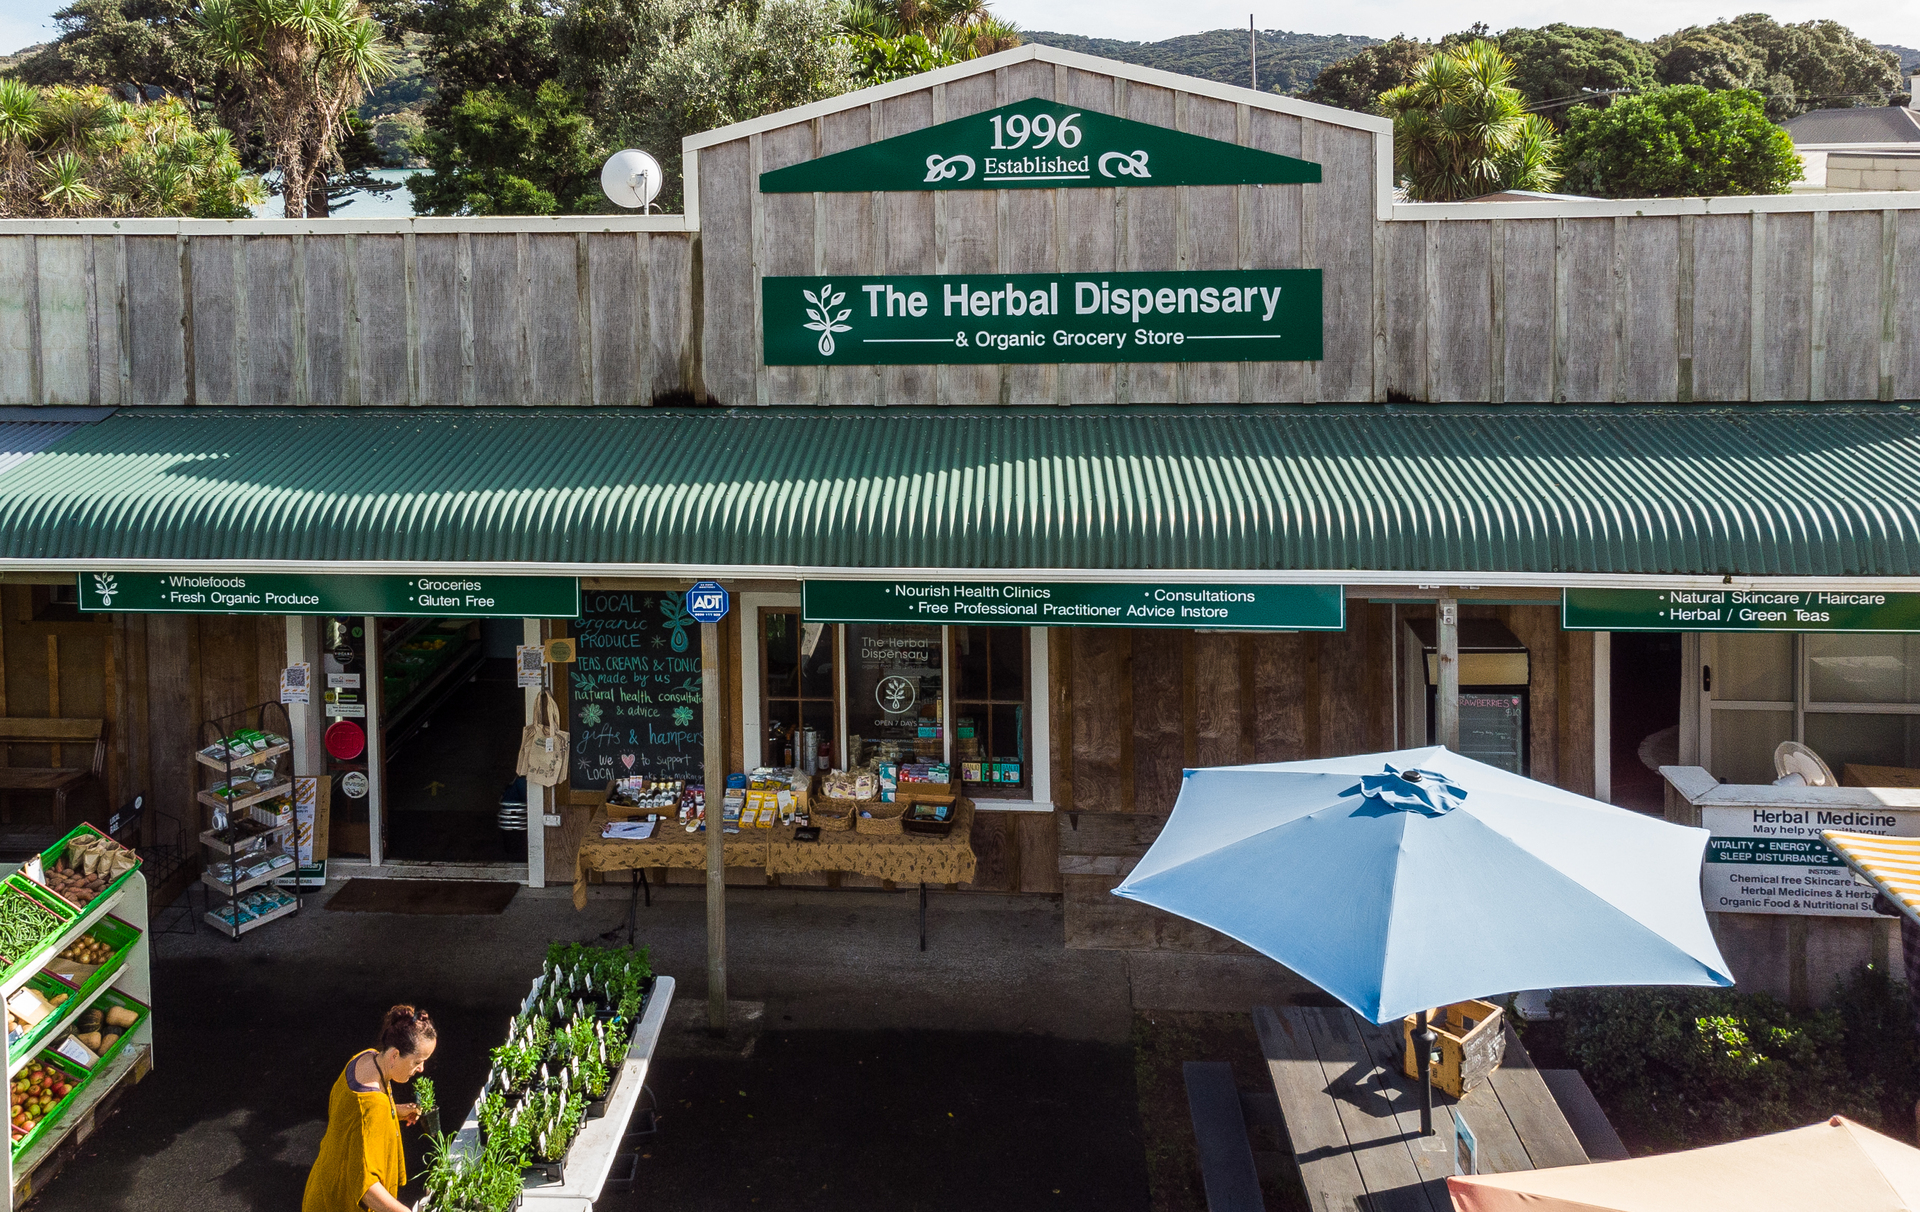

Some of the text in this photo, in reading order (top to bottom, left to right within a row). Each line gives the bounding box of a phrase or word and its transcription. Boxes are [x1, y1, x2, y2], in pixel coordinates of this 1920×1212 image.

[989, 113, 1083, 151] 1996
[984, 156, 1090, 175] Established
[862, 280, 1282, 323] The Herbal Dispensary
[955, 328, 1185, 351] & Organic Grocery Store
[169, 575, 246, 589] Wholefoods
[417, 578, 482, 592] Groceries
[170, 590, 319, 607] Fresh Organic Produce
[895, 584, 1051, 600] Nourish Health Clinics
[1154, 588, 1256, 603] Consultations
[1669, 591, 1886, 606] Natural Skincare / Haircare
[418, 594, 495, 608] Gluten Free
[585, 594, 641, 613] LOCAL
[694, 595, 722, 609] ADT
[918, 601, 1229, 619] Free Professional Practitioner Advice Instore
[1669, 608, 1830, 622] Herbal / Green Teas
[574, 617, 648, 636] organic
[580, 633, 641, 648] PRODUCE
[861, 637, 929, 648] The Herbal
[861, 648, 929, 662] Dispensary
[606, 656, 648, 671] CREAMS
[653, 659, 665, 671] &
[666, 657, 702, 672] TONIC
[597, 672, 671, 687] made by us
[574, 687, 615, 702] natural
[619, 685, 653, 704] health
[1459, 698, 1510, 708] RAWBERRIES
[616, 705, 660, 717] & advice
[576, 722, 621, 754] gifts
[628, 729, 639, 745] &
[598, 752, 692, 771] We to support
[1753, 809, 1897, 826] Herbal Medicine
[1753, 825, 1777, 834] May
[1779, 826, 1805, 836] help
[1807, 827, 1824, 836] yo
[1710, 840, 1811, 851] VITALITY ENERGY
[1720, 852, 1829, 863] SLEEP DISTURBANCE
[1729, 874, 1779, 884] Chemical
[1781, 875, 1802, 885] free
[1804, 876, 1851, 887] Skincare
[1741, 886, 1878, 900] Herbal Medicines & Herba
[1719, 897, 1762, 908] Organic
[1763, 898, 1791, 908] Food
[1793, 899, 1799, 908] &
[1803, 900, 1859, 910] Nutritional
